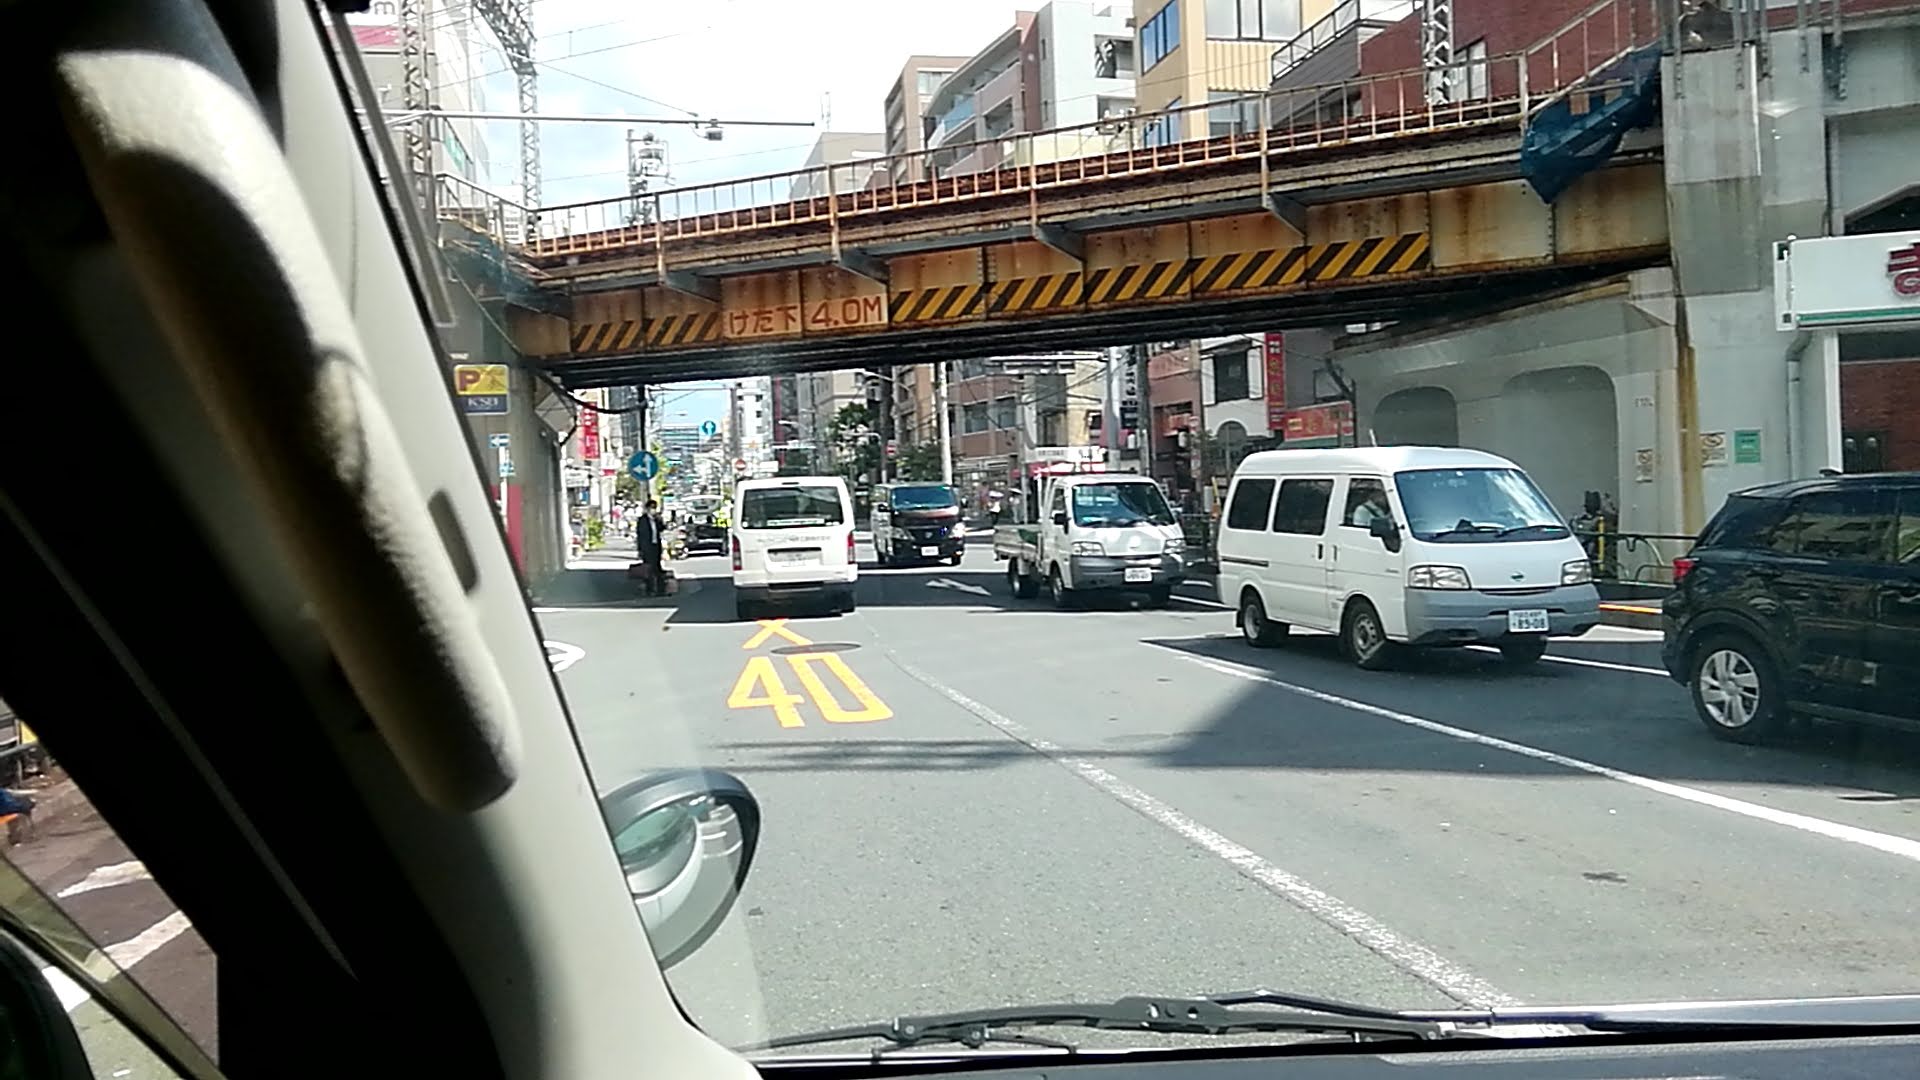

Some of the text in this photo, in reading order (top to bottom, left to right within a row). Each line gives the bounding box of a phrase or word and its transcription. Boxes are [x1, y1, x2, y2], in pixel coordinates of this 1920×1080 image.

[729, 296, 883, 335] けた下 4.0M
[458, 370, 481, 392] P
[727, 653, 894, 728] 40
